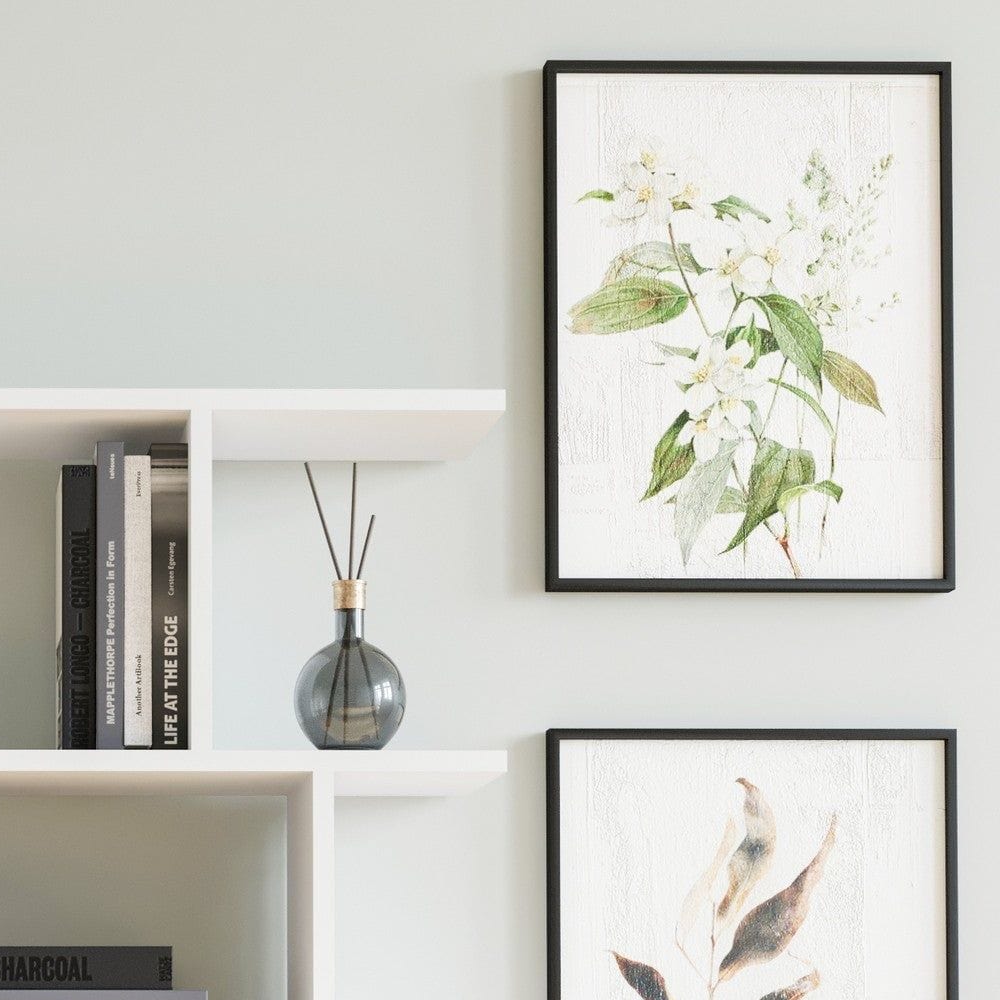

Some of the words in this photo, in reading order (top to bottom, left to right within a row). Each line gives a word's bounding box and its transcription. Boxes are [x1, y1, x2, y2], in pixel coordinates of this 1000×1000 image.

[71, 529, 90, 609] CHARCOAL
[106, 541, 115, 568] Form
[106, 572, 115, 582] in
[106, 584, 115, 635] Perfection
[164, 616, 178, 654] EDGE
[107, 638, 115, 724] MAPPLETHORPE
[164, 659, 178, 690] THE
[164, 693, 178, 712] AT
[164, 714, 178, 745] LIFE
